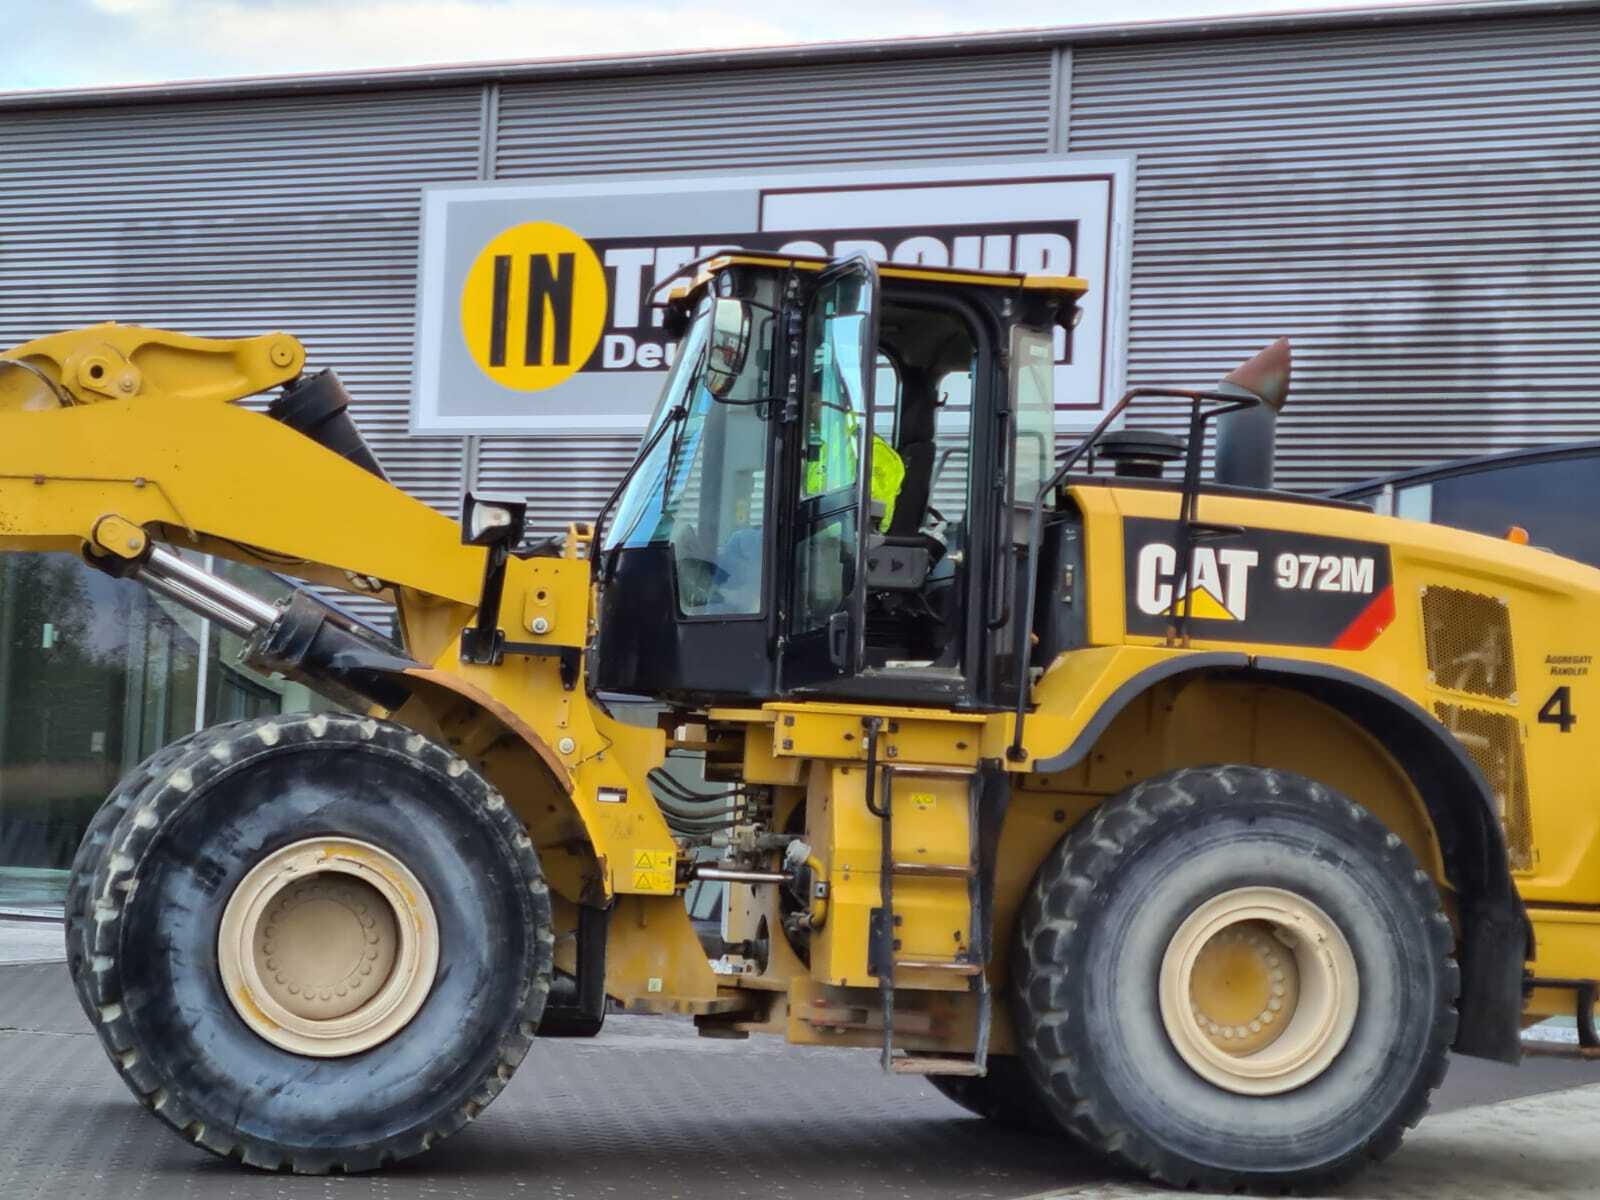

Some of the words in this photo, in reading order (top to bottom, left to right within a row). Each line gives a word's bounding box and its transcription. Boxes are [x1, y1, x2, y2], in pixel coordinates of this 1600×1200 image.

[1137, 543, 1259, 621] CAT
[1275, 553, 1375, 594] 972M
[1537, 686, 1577, 732] 4
